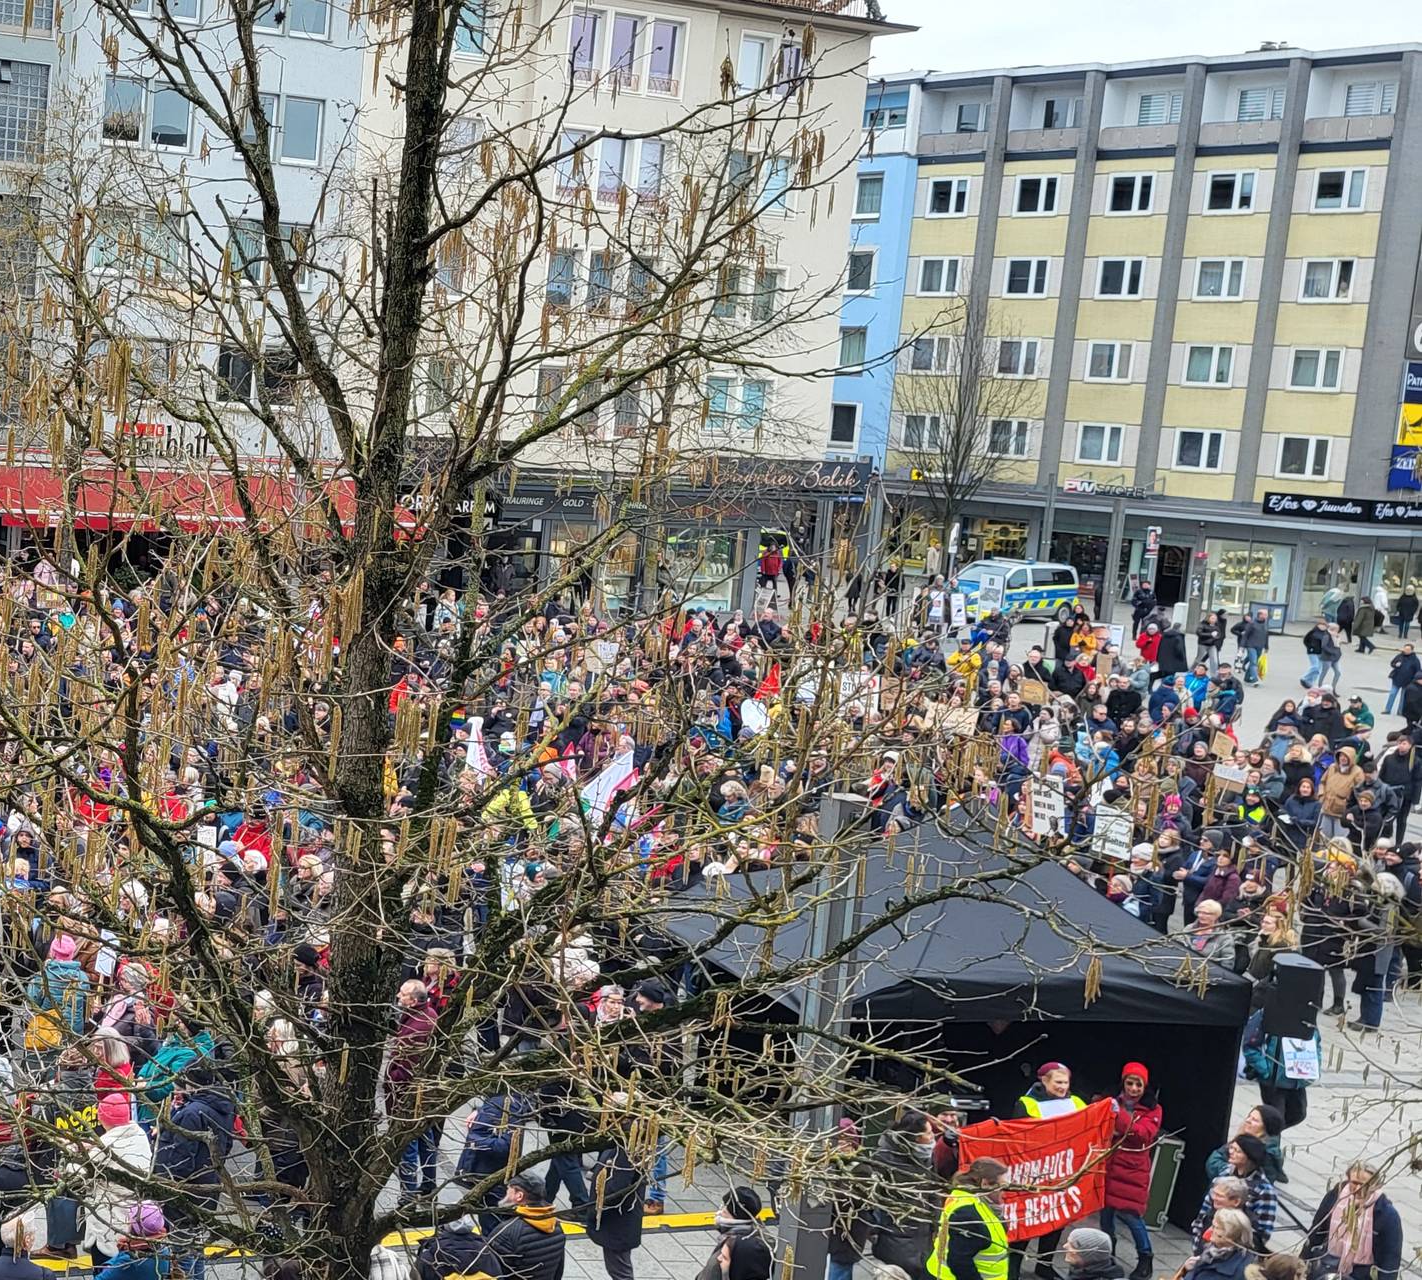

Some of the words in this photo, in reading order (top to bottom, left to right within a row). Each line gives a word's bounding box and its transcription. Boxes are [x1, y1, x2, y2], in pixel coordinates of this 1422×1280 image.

[800, 462, 861, 488] Balik
[502, 496, 545, 507] TRAURINGE
[563, 498, 585, 508] GOLD
[1268, 495, 1300, 511] Efes
[1316, 500, 1362, 515] Juwelier
[1375, 502, 1395, 517] Efes
[1025, 1185, 1082, 1227] RECHTS
